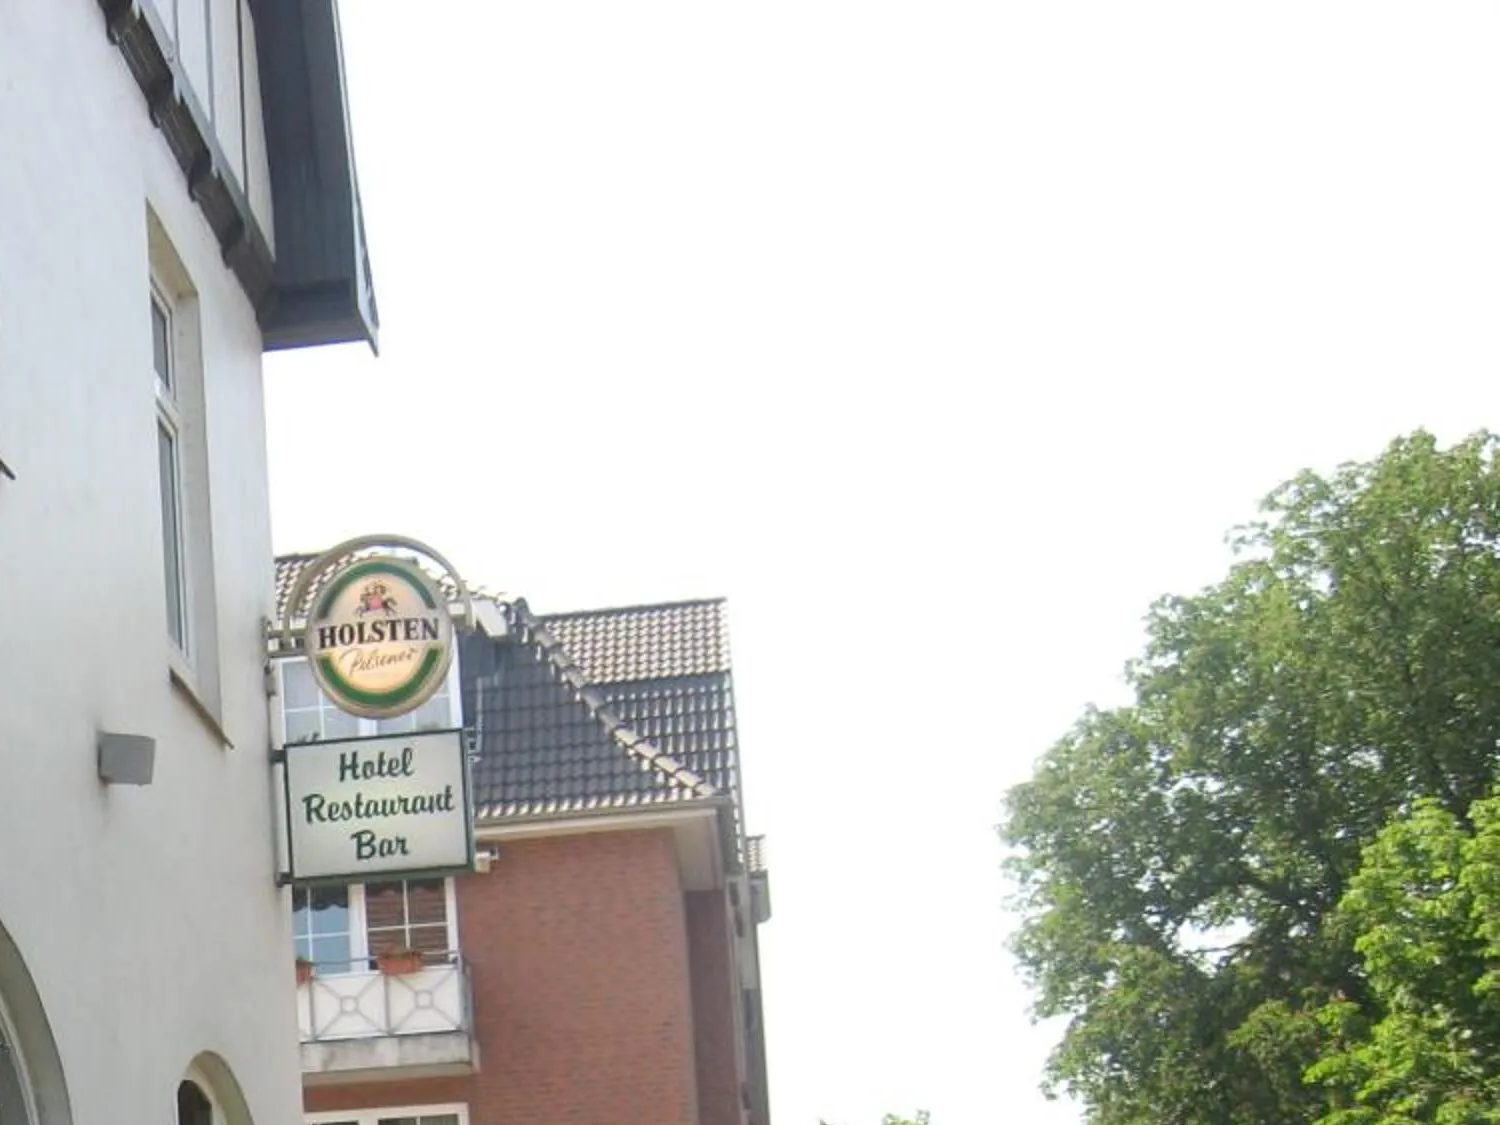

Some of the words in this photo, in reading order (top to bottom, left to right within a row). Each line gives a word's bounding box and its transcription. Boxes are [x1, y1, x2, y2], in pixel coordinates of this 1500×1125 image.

[318, 618, 440, 649] HOLSTEN
[339, 748, 414, 782] Hotel
[302, 786, 455, 824] Restaurant
[351, 829, 410, 860] Bar
